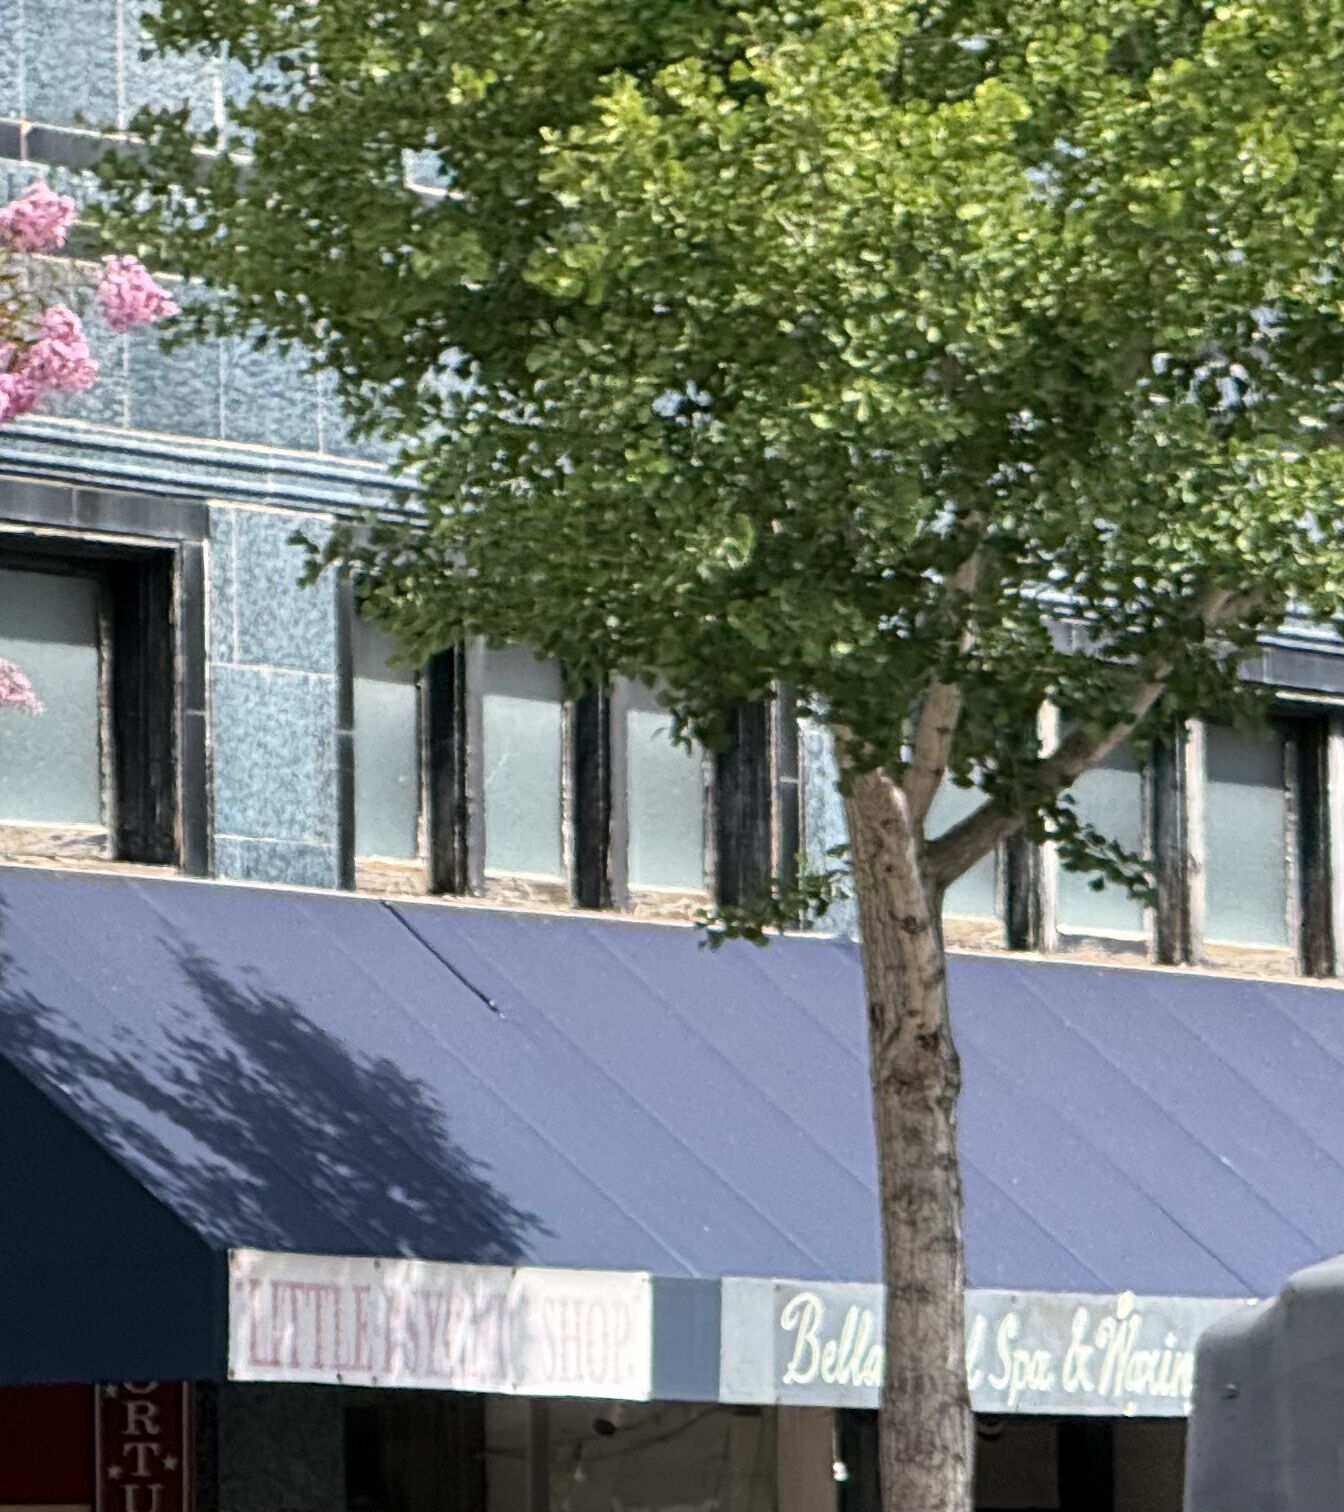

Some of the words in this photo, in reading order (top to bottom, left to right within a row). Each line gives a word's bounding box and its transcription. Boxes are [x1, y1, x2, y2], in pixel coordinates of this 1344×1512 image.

[247, 1279, 372, 1371] LITTLE
[988, 1312, 1055, 1408] Spa
[1062, 1305, 1097, 1393] &
[1094, 1312, 1195, 1397] Waxin
